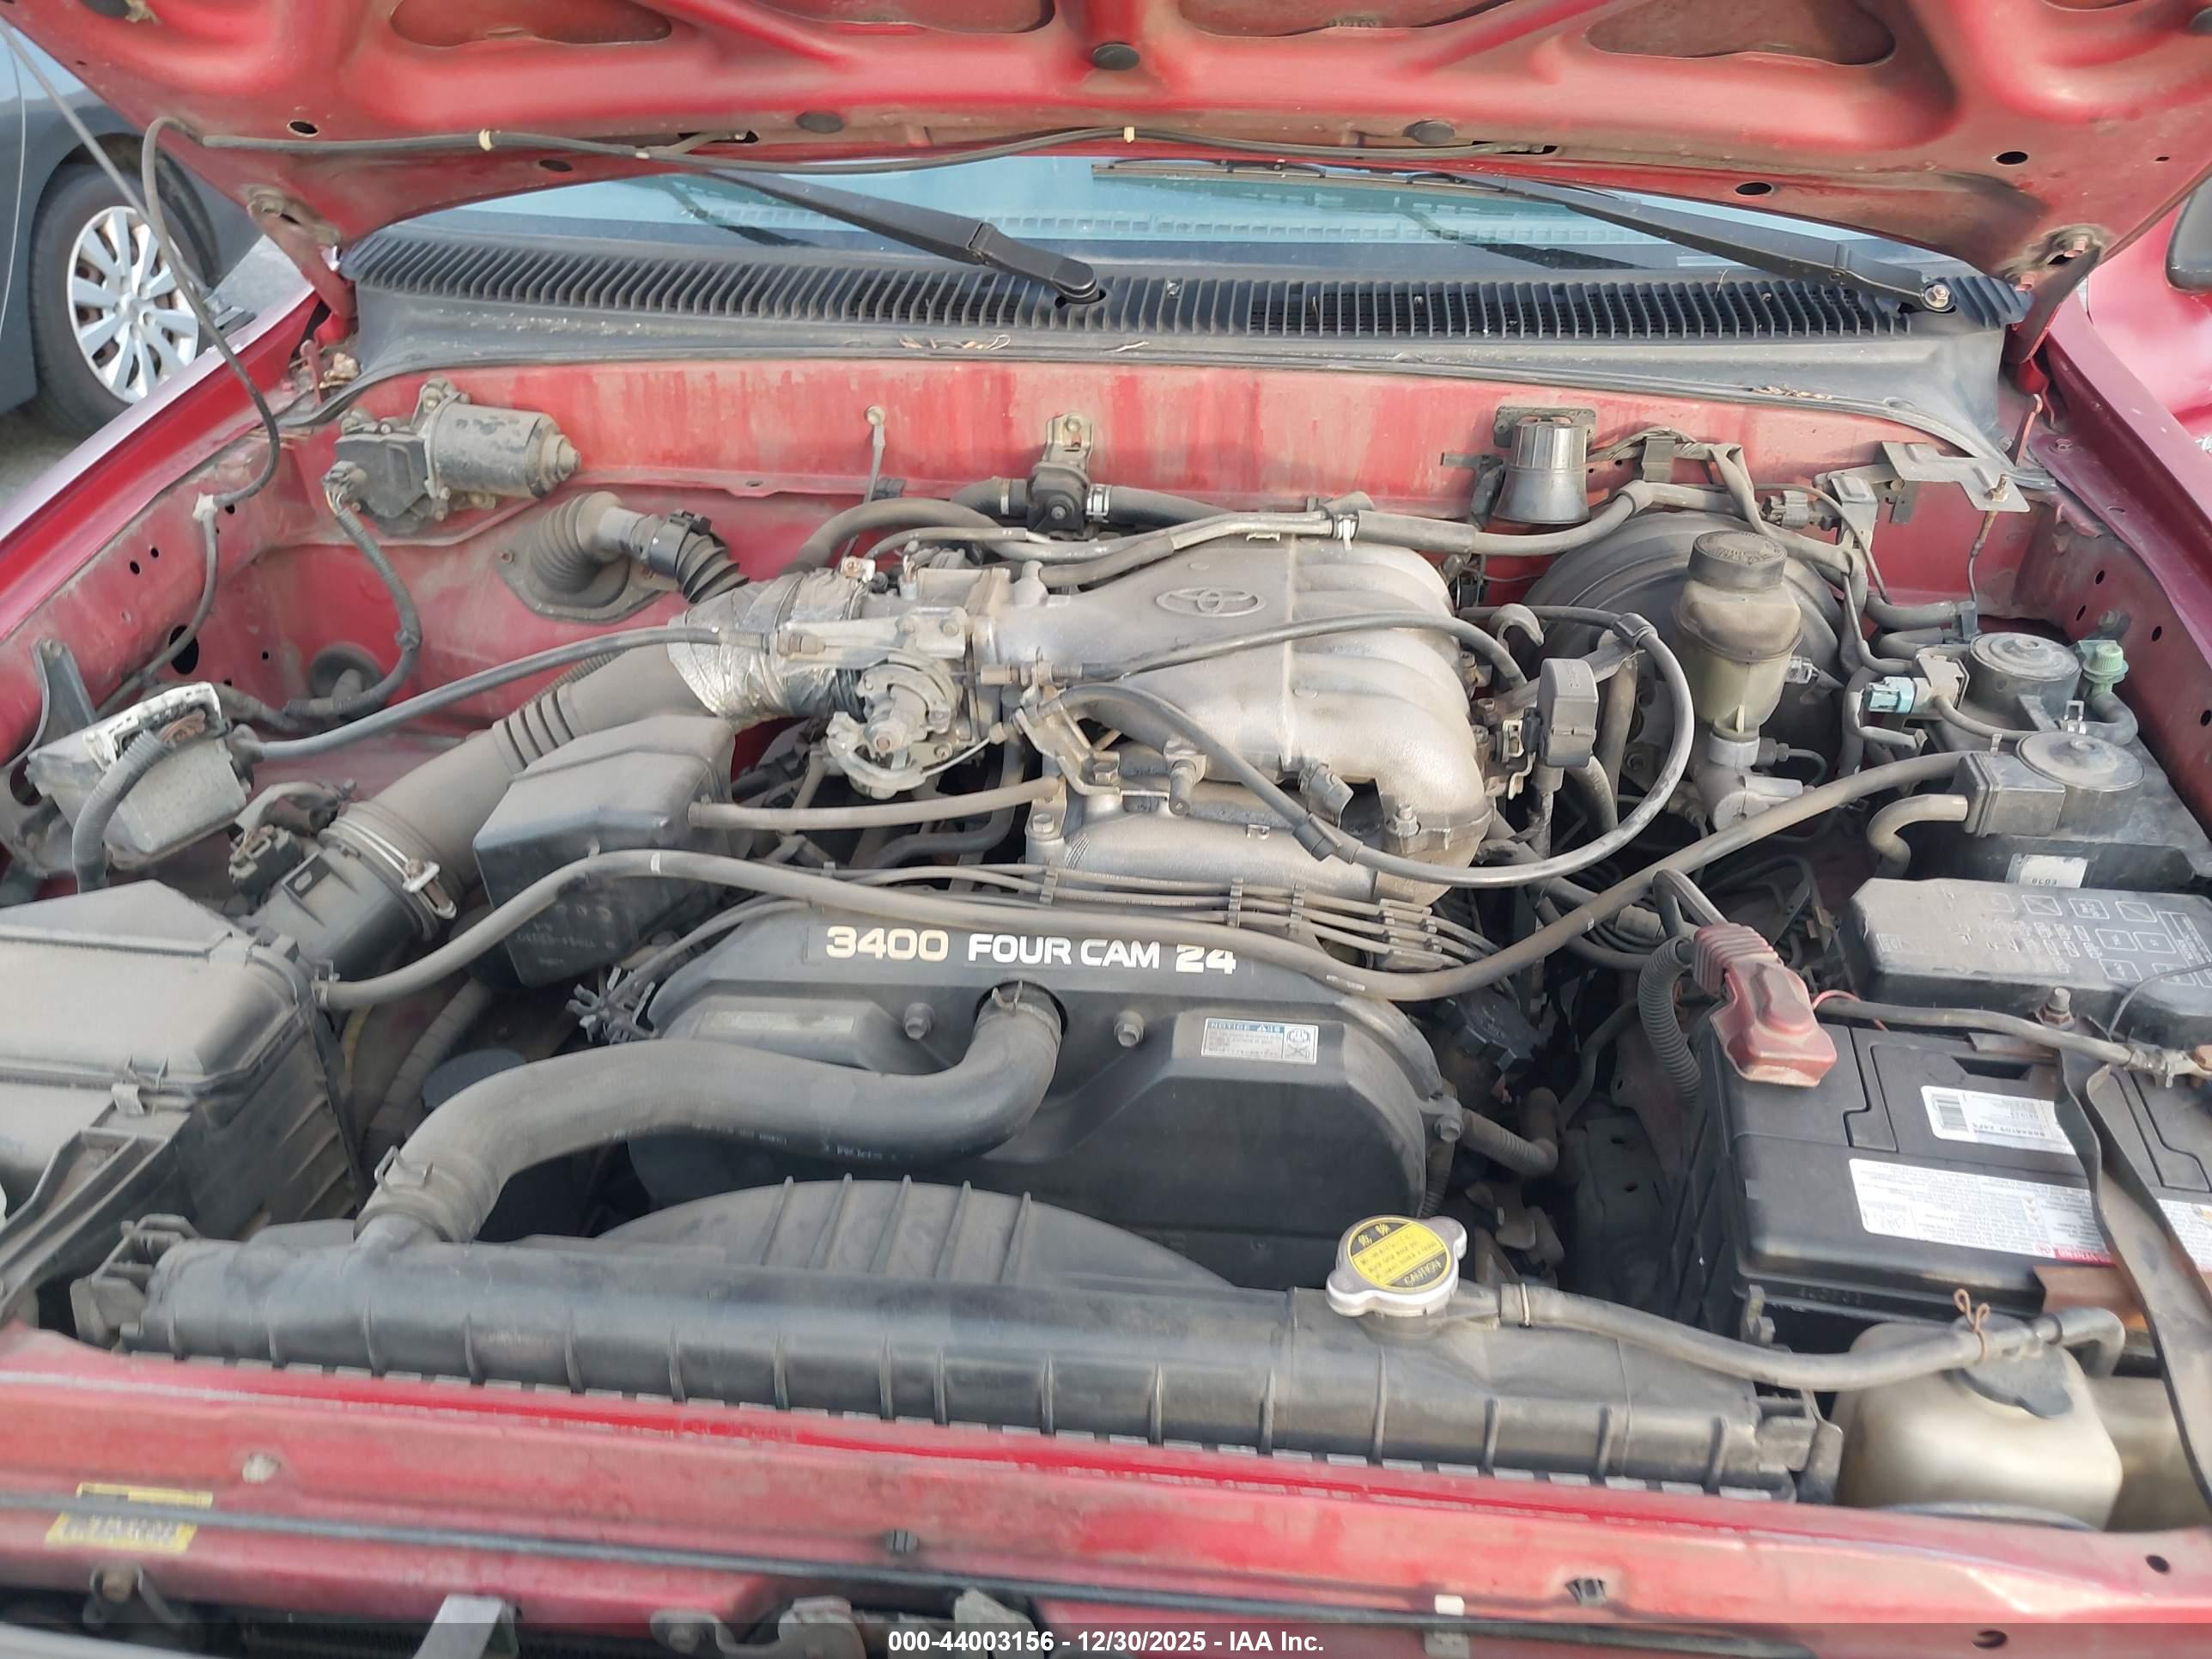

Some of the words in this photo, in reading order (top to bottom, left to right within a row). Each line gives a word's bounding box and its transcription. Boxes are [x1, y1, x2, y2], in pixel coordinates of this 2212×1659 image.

[826, 926, 949, 963] 3400
[968, 933, 1071, 965] FOUR
[1080, 939, 1160, 969] CAM
[1176, 943, 1237, 975] 24
[1404, 1259, 1442, 1285] CAUTION
